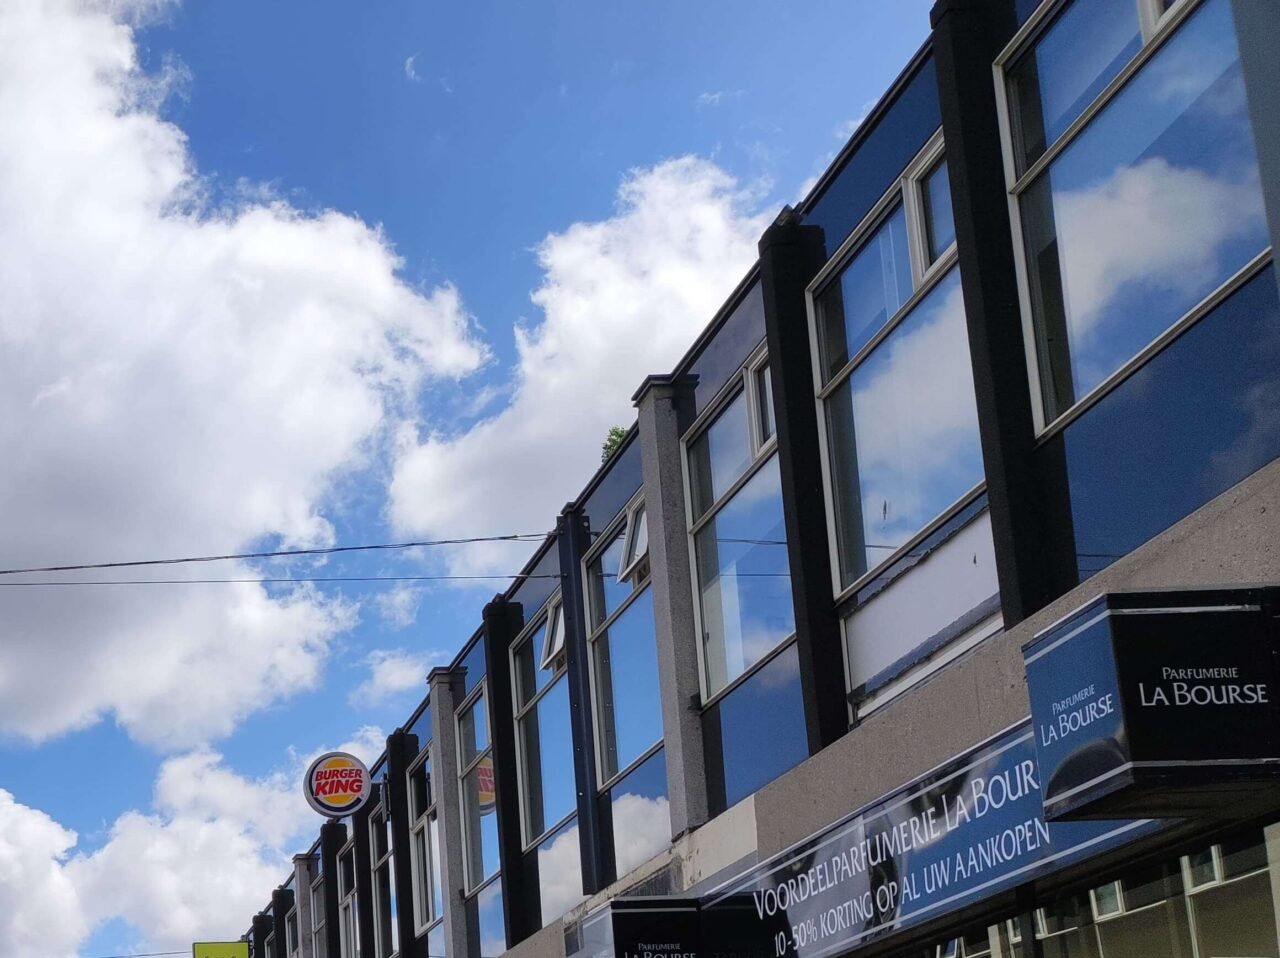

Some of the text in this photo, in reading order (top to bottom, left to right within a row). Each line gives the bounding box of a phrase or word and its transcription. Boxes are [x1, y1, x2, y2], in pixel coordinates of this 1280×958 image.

[1162, 667, 1239, 680] PARFUMERIE
[1052, 684, 1096, 715] PARFUMERIE
[1138, 683, 1269, 706] LA BOURSE
[1041, 693, 1114, 747] LA BOURSE
[315, 769, 362, 782] BURGER
[314, 779, 363, 797] KING
[753, 759, 1040, 920] VOORDEELPARFUMERIE LA BOUR
[820, 890, 873, 937] KORTING
[877, 881, 898, 913] OP
[902, 879, 920, 904] AL
[923, 860, 950, 894] UW
[954, 817, 1050, 881] AANKOPEN
[638, 943, 681, 951] PARFUMERIE
